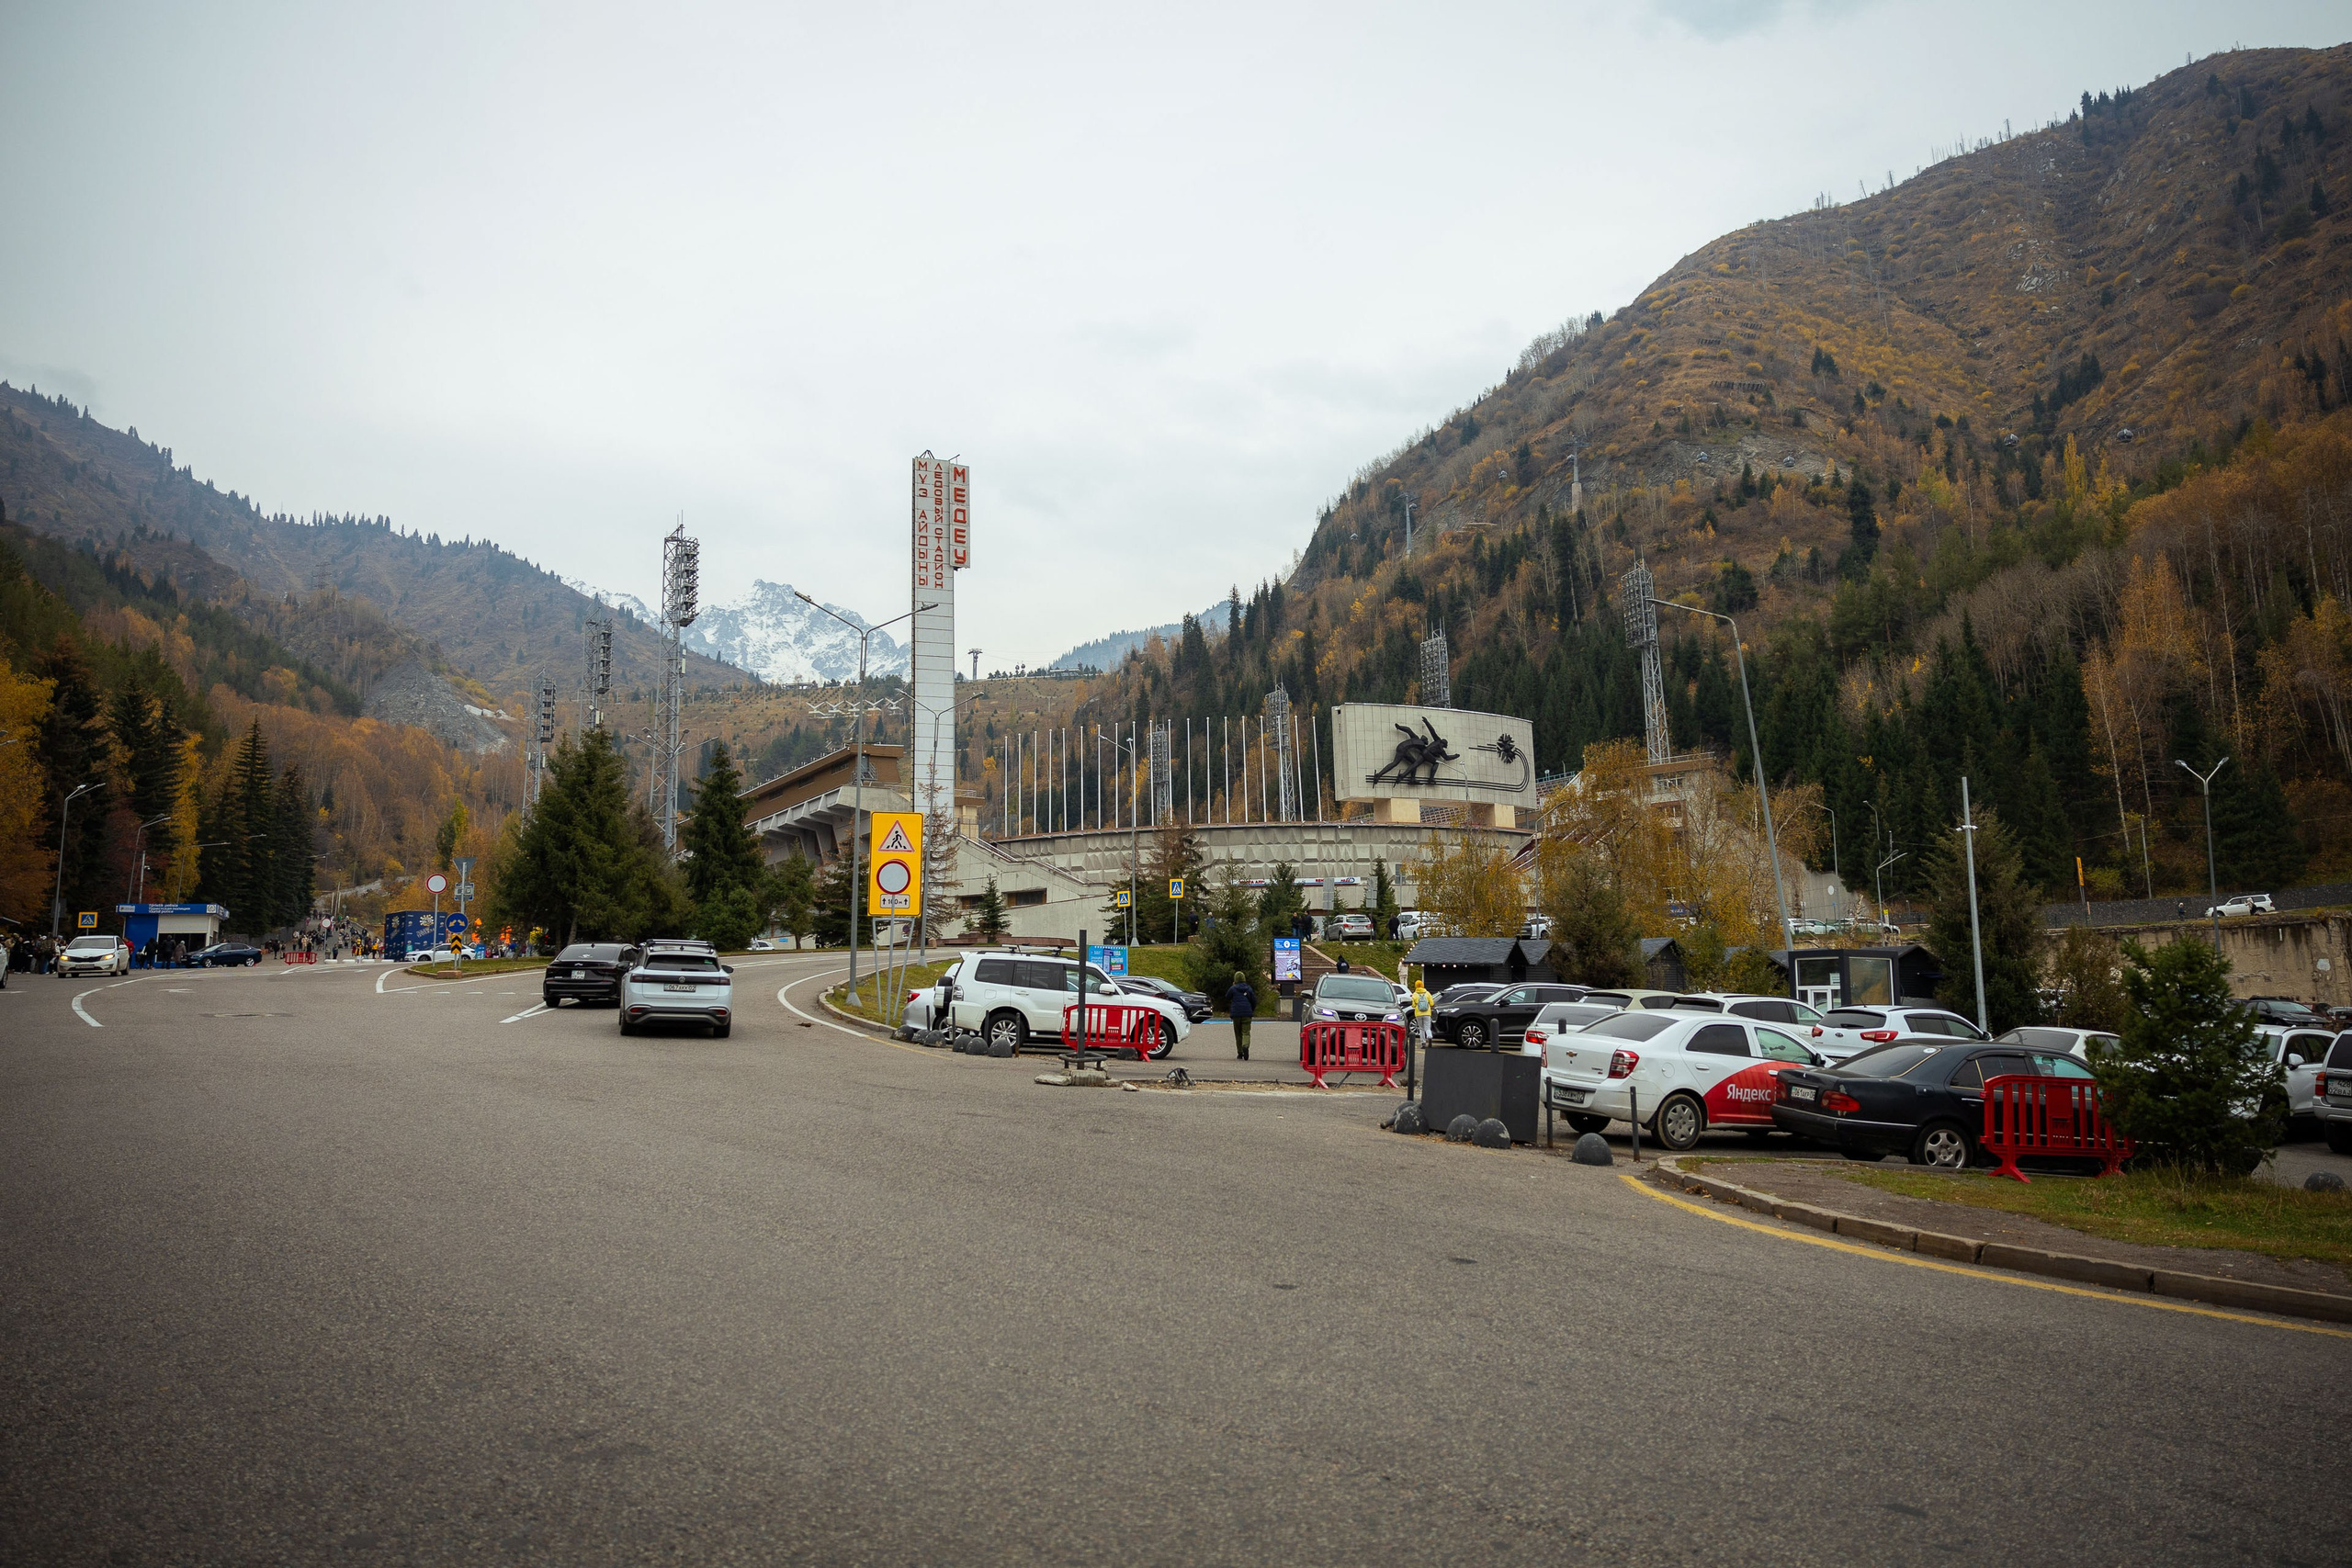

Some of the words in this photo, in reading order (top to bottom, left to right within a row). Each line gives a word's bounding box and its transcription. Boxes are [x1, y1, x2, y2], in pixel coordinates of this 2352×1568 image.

[934, 462, 944, 523] ЛЕДОВЫЙ
[953, 466, 967, 564] МЕДЕУ
[918, 510, 928, 586] АЙДЫНЫ
[934, 527, 944, 589] СТАДИОН
[1726, 1084, 1771, 1102] Яндекс
